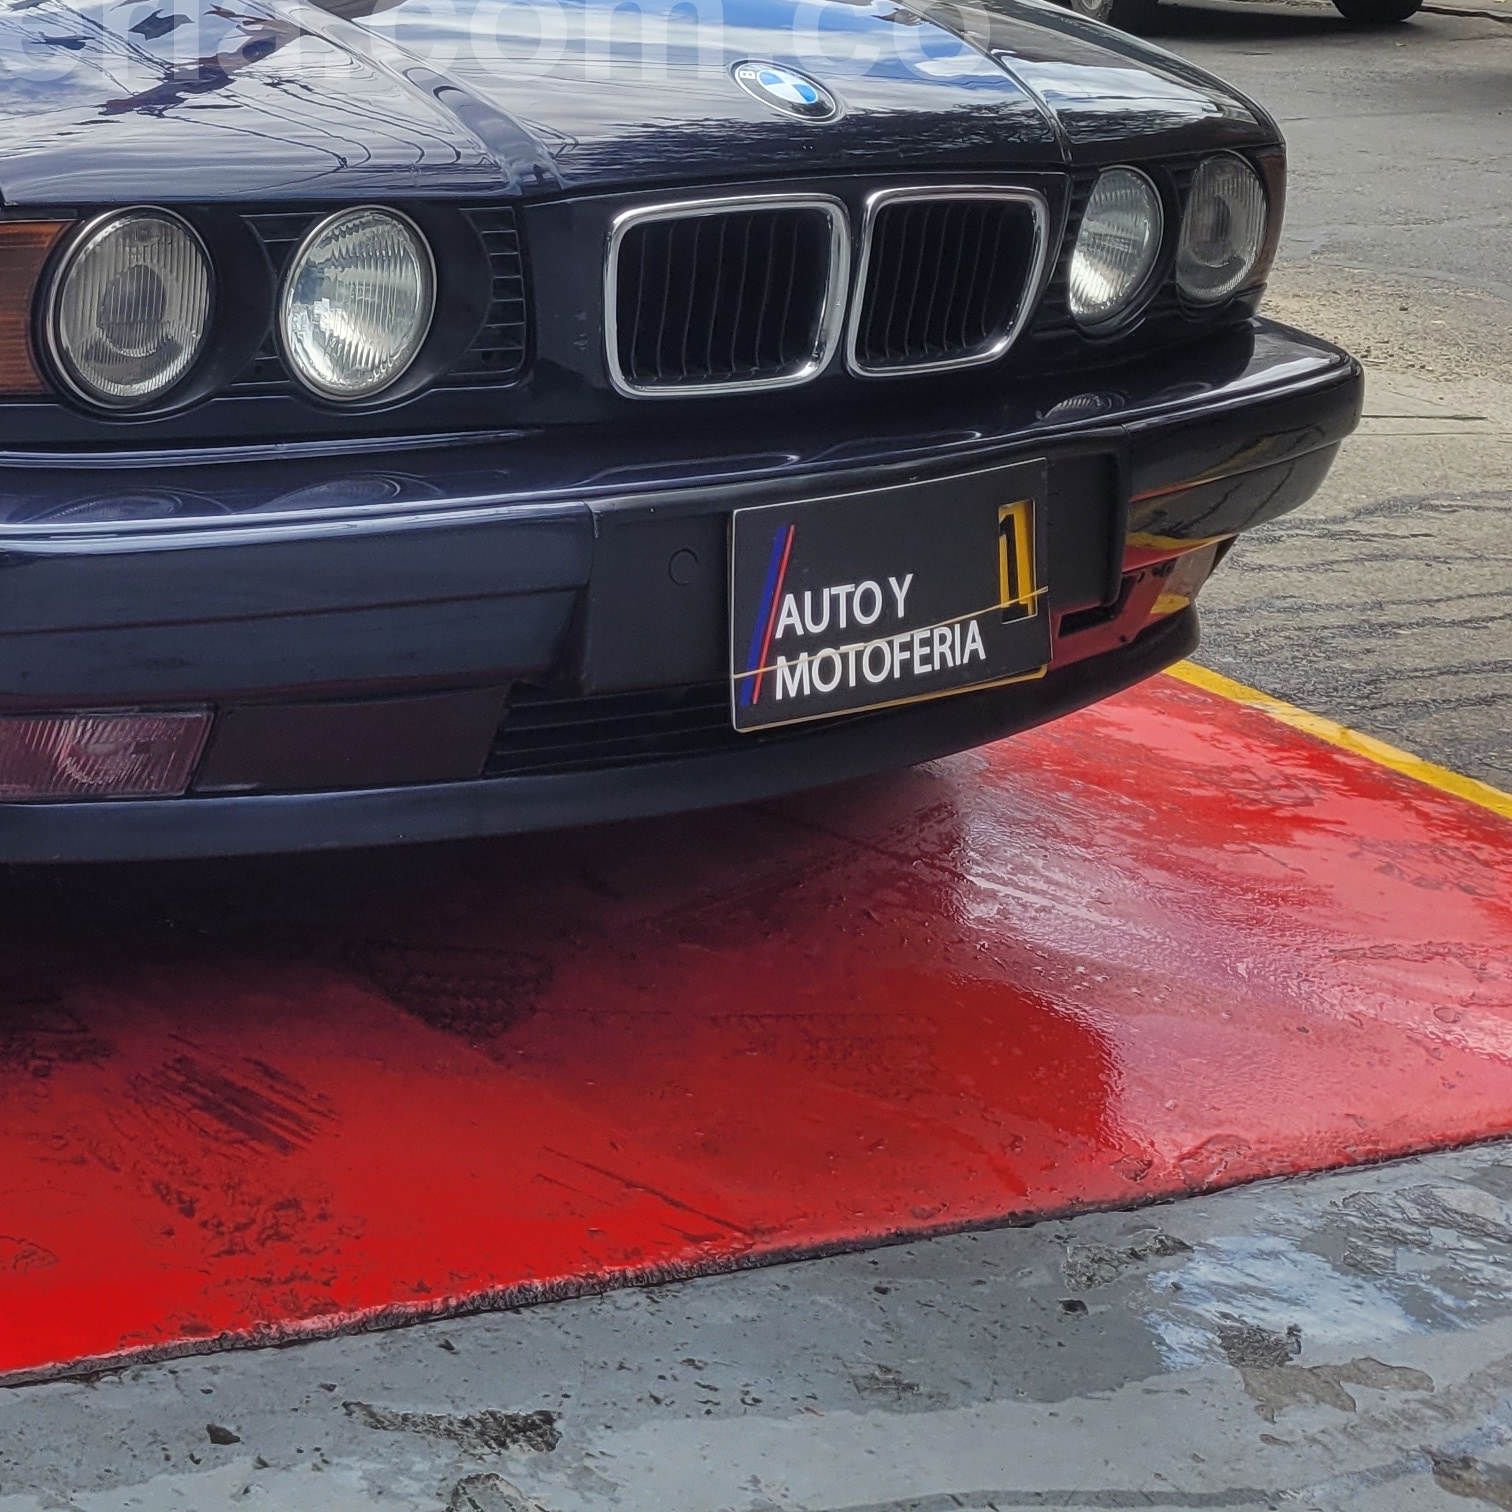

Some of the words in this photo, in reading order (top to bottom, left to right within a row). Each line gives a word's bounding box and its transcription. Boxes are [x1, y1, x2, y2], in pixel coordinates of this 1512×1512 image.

[775, 580, 883, 639] AUTO
[889, 573, 914, 619] Y
[775, 619, 986, 701] MOTOFERIA
